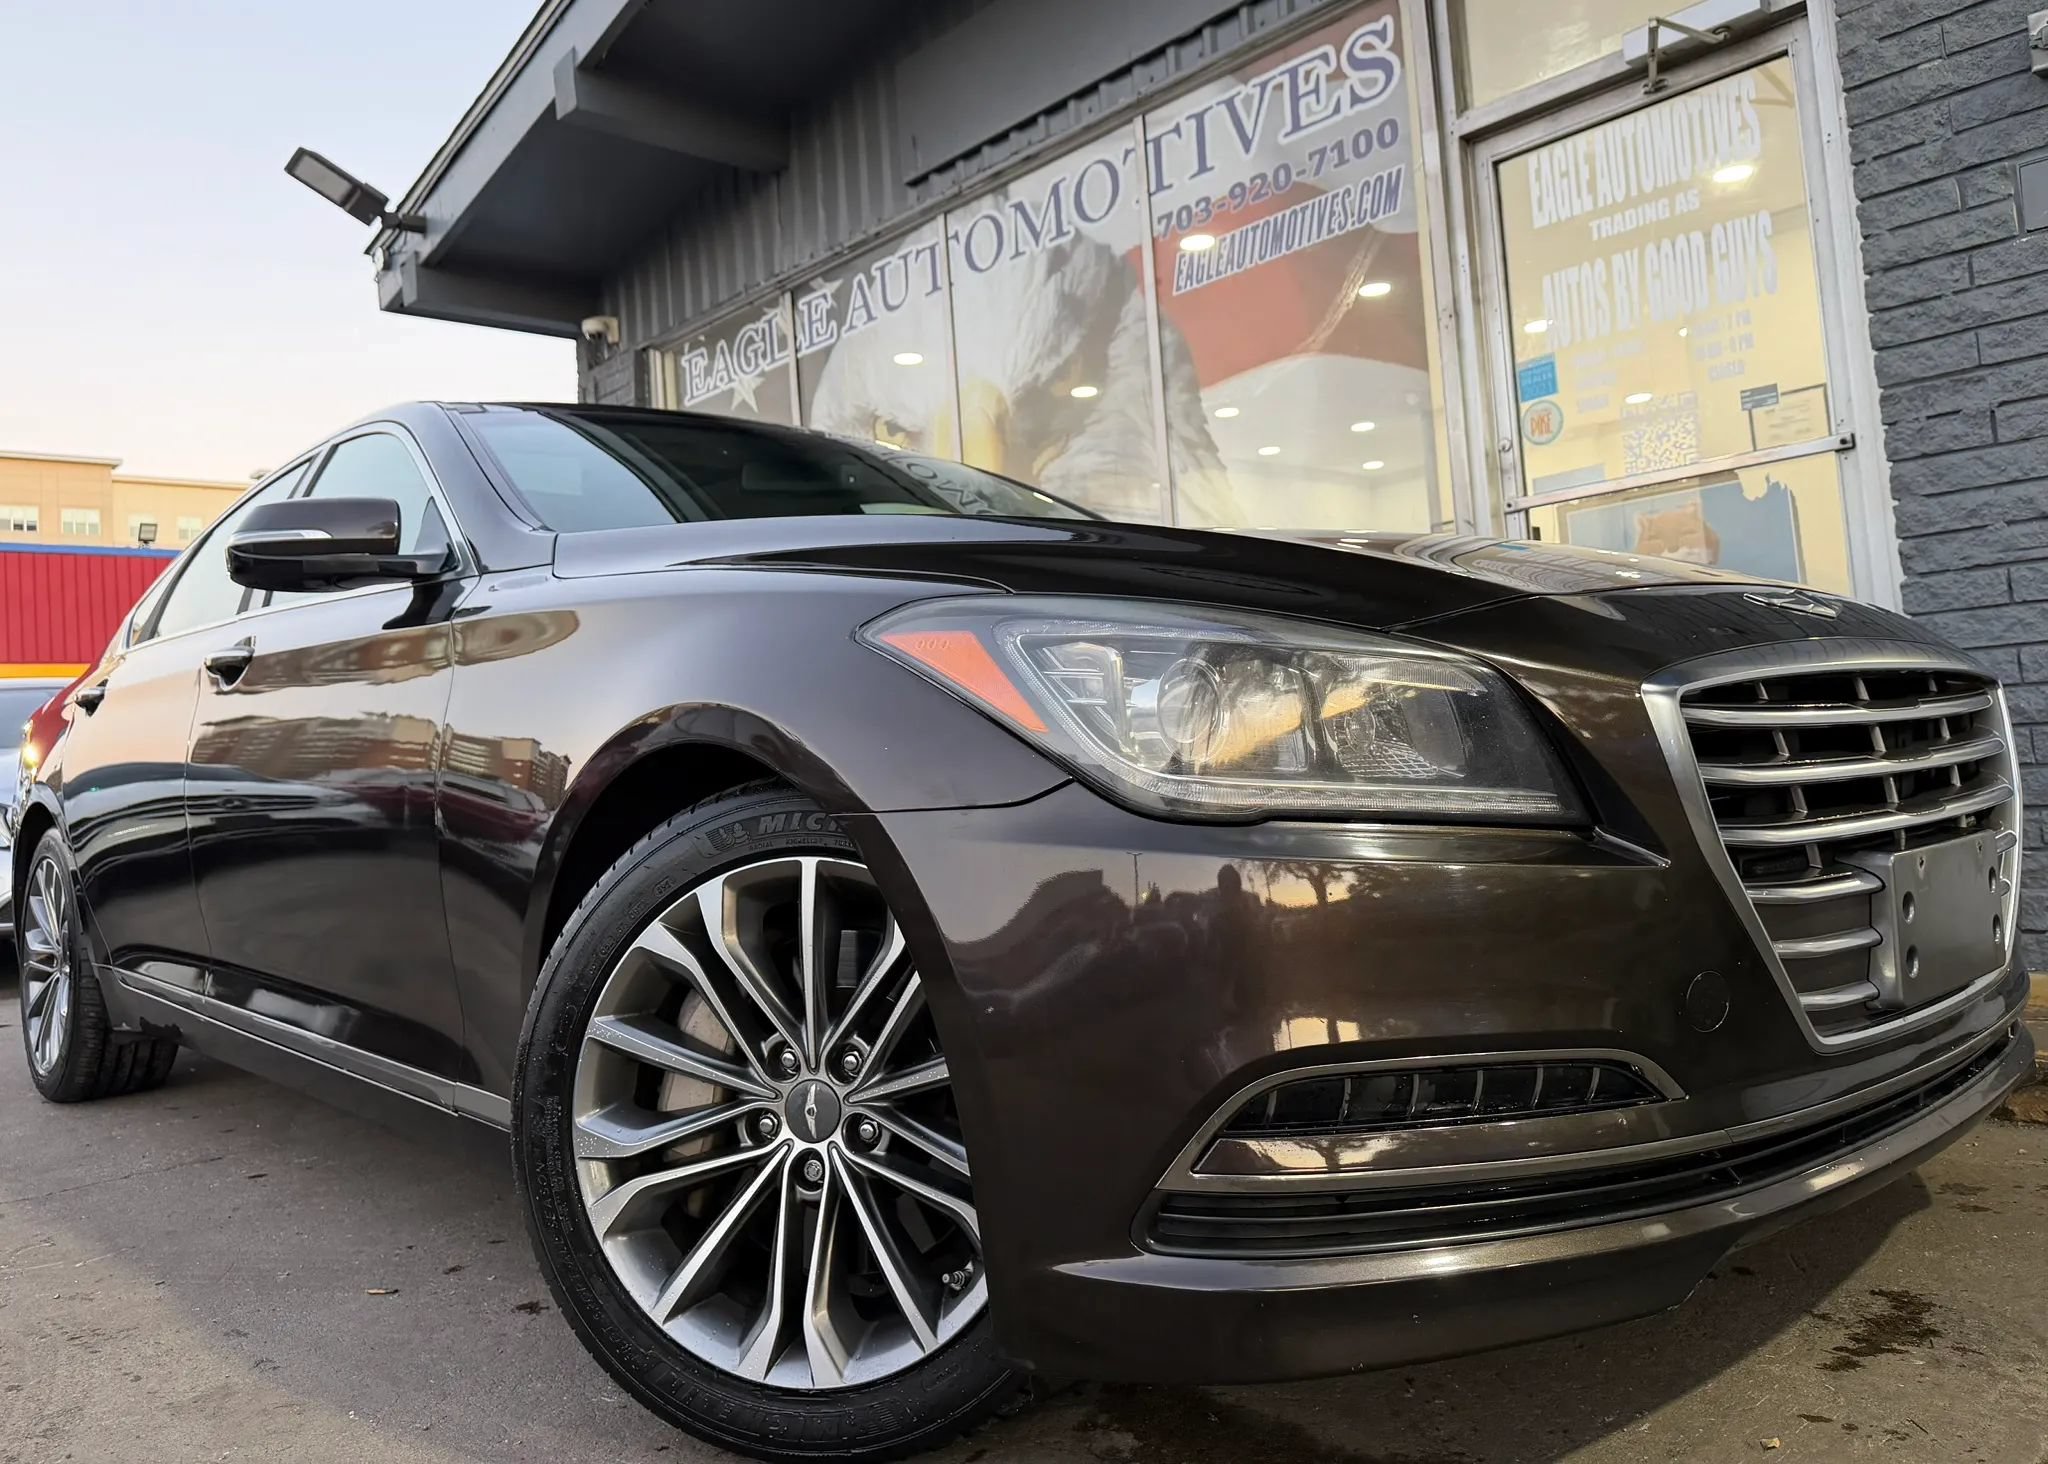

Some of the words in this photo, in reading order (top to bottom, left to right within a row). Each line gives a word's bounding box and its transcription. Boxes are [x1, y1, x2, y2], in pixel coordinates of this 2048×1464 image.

[682, 288, 838, 407] EAGLE
[842, 14, 1401, 335] AUTOMOTIVES
[1156, 117, 1400, 241] 703-920-7100
[1528, 138, 1593, 228] EAGLE
[1594, 76, 1761, 206] AUTOMOTIVES
[1588, 198, 1670, 240] TRADING
[1676, 189, 1700, 215] AS
[1173, 163, 1405, 295] EAGLEAUTOMOTIVES.COM
[1542, 258, 1611, 350] AUTOS
[1611, 248, 1640, 331] BY
[1645, 231, 1708, 322] GOOD
[1711, 210, 1778, 304] GUYS
